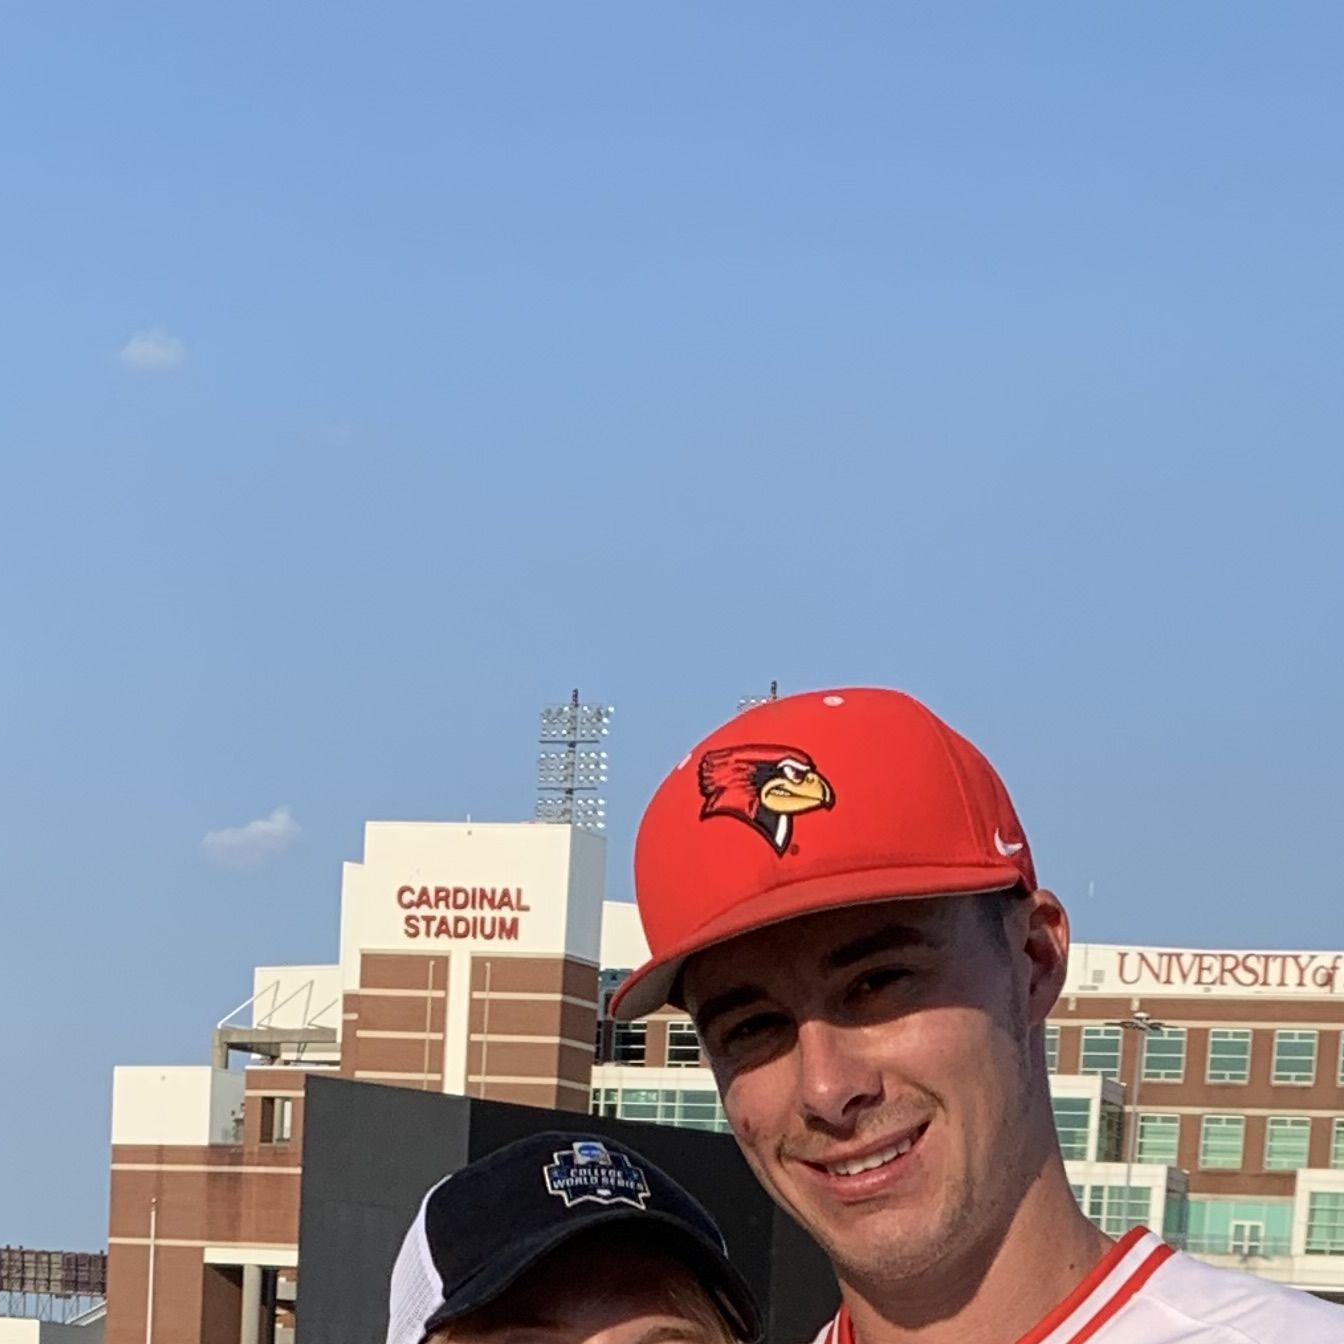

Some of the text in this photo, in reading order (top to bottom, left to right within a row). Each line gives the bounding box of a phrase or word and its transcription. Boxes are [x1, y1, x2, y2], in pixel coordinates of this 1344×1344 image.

[397, 885, 531, 912] CARDINAL
[404, 915, 519, 940] STADIUM
[1117, 952, 1316, 988] UNIVERSITY
[1312, 954, 1343, 994] of
[553, 1176, 598, 1189] WORLD
